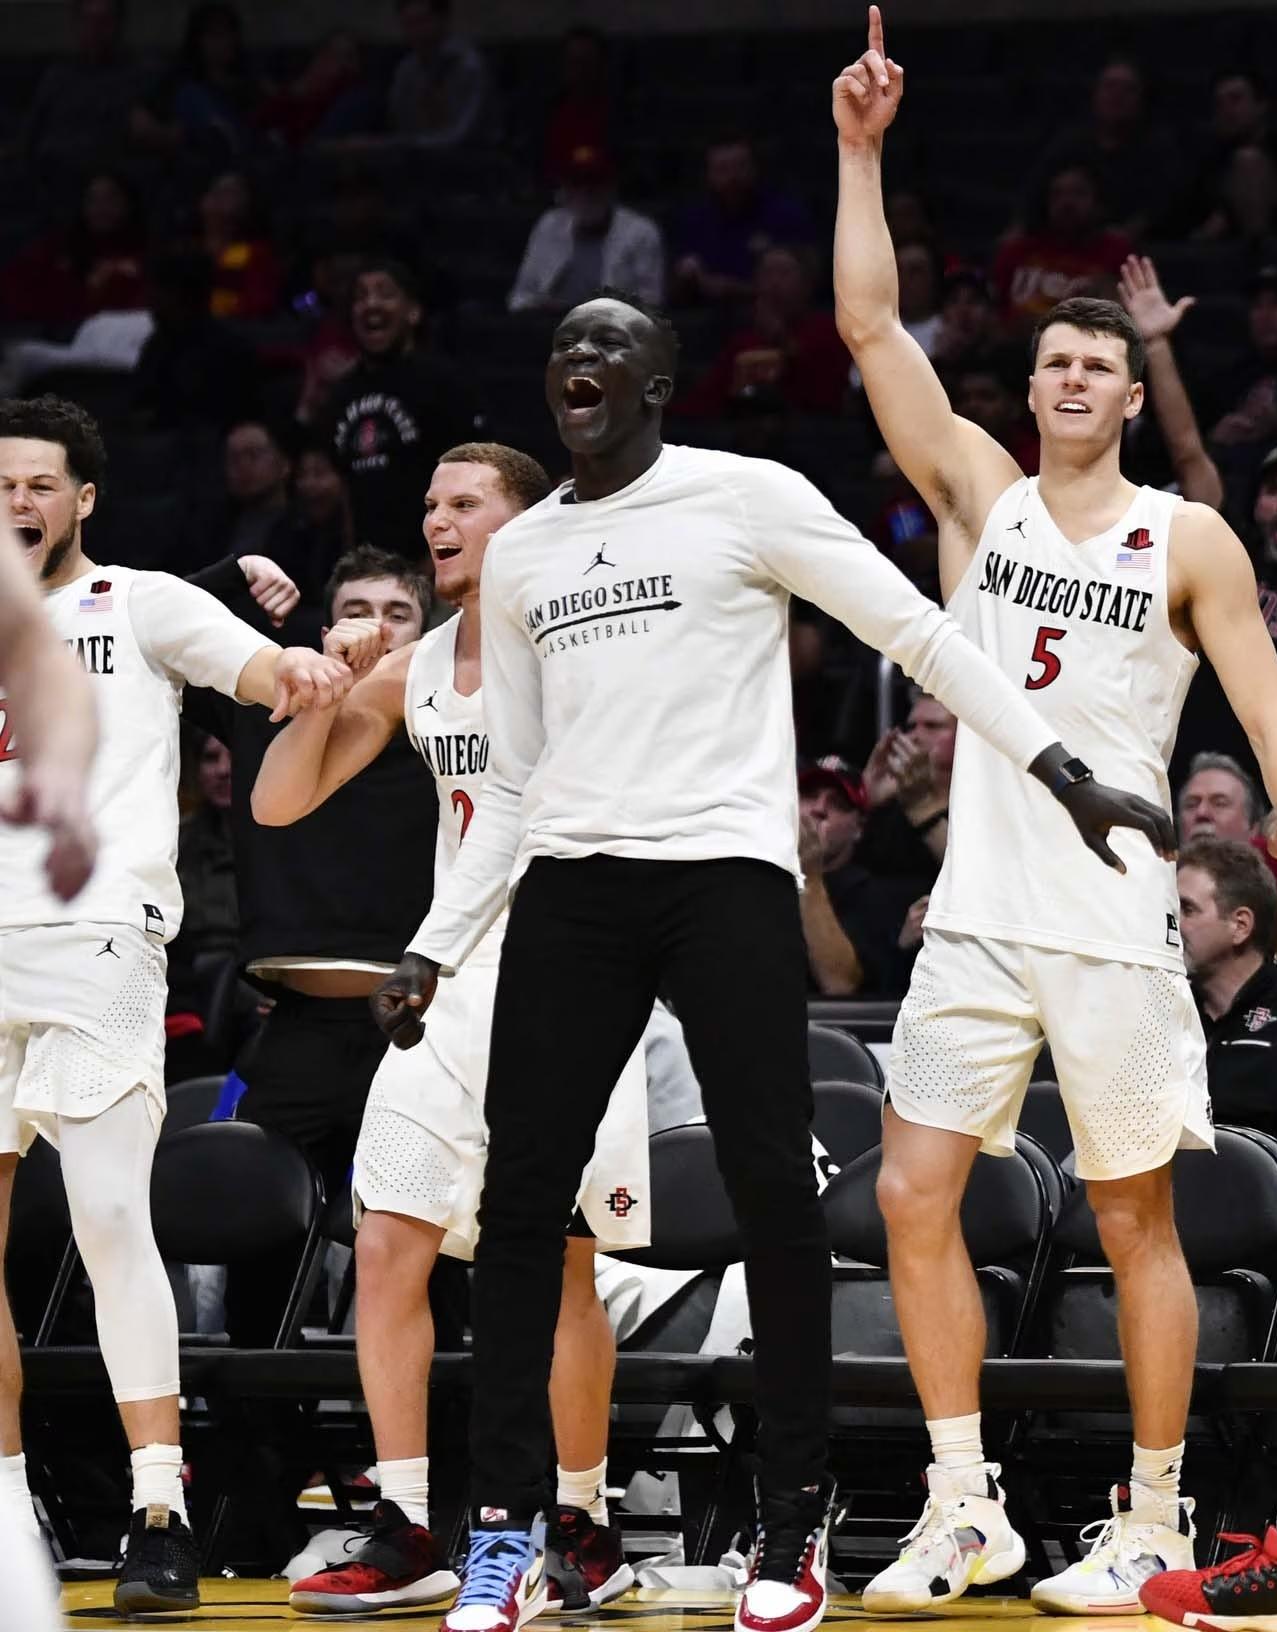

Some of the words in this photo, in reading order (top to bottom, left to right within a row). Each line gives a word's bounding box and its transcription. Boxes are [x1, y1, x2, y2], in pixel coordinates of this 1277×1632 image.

[549, 587, 607, 620] DIEGO
[612, 574, 673, 604] STATE
[979, 551, 1018, 598] SAN
[1013, 565, 1081, 618] DIEGO
[1079, 580, 1153, 632] STATE
[1024, 626, 1068, 690] 5
[434, 733, 489, 777] DIEGO
